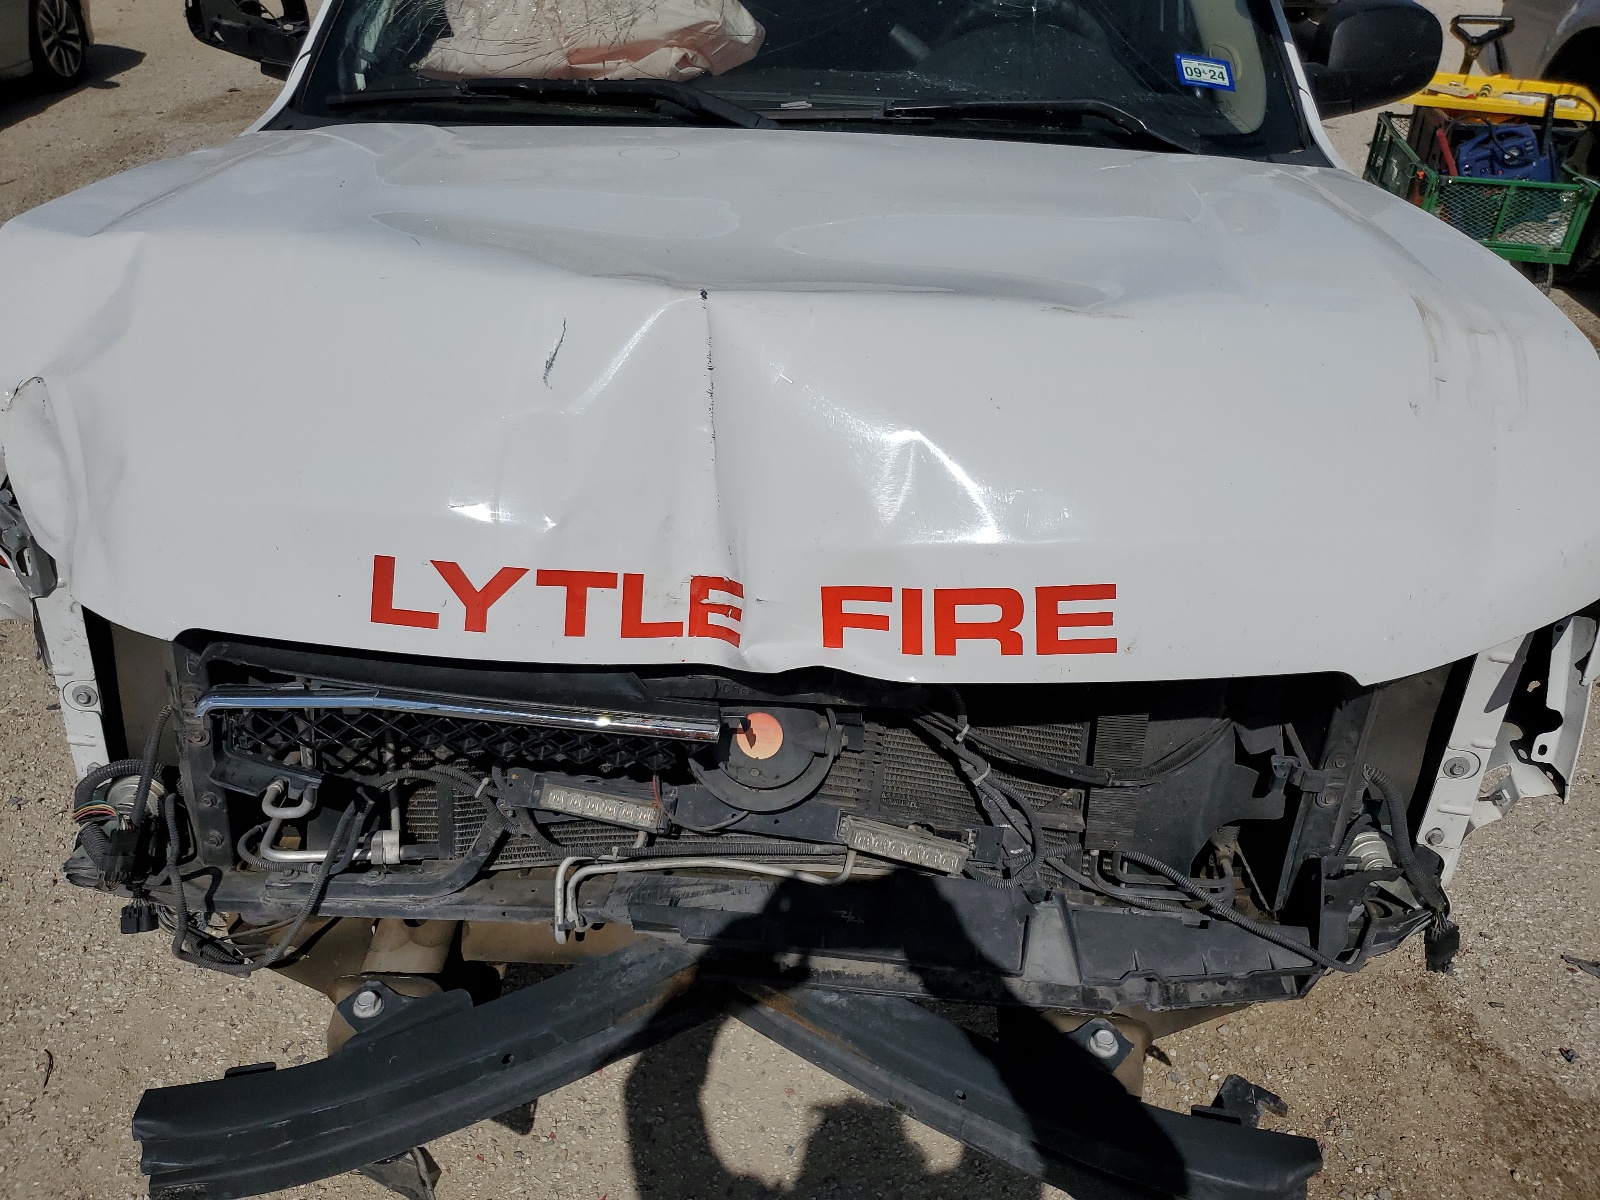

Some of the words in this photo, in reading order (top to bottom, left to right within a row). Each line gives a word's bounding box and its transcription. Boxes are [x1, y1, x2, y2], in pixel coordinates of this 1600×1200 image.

[1185, 66, 1202, 78] 09
[1208, 69, 1226, 82] 24
[371, 556, 742, 646] LYTLE
[821, 583, 1117, 656] FIRE
